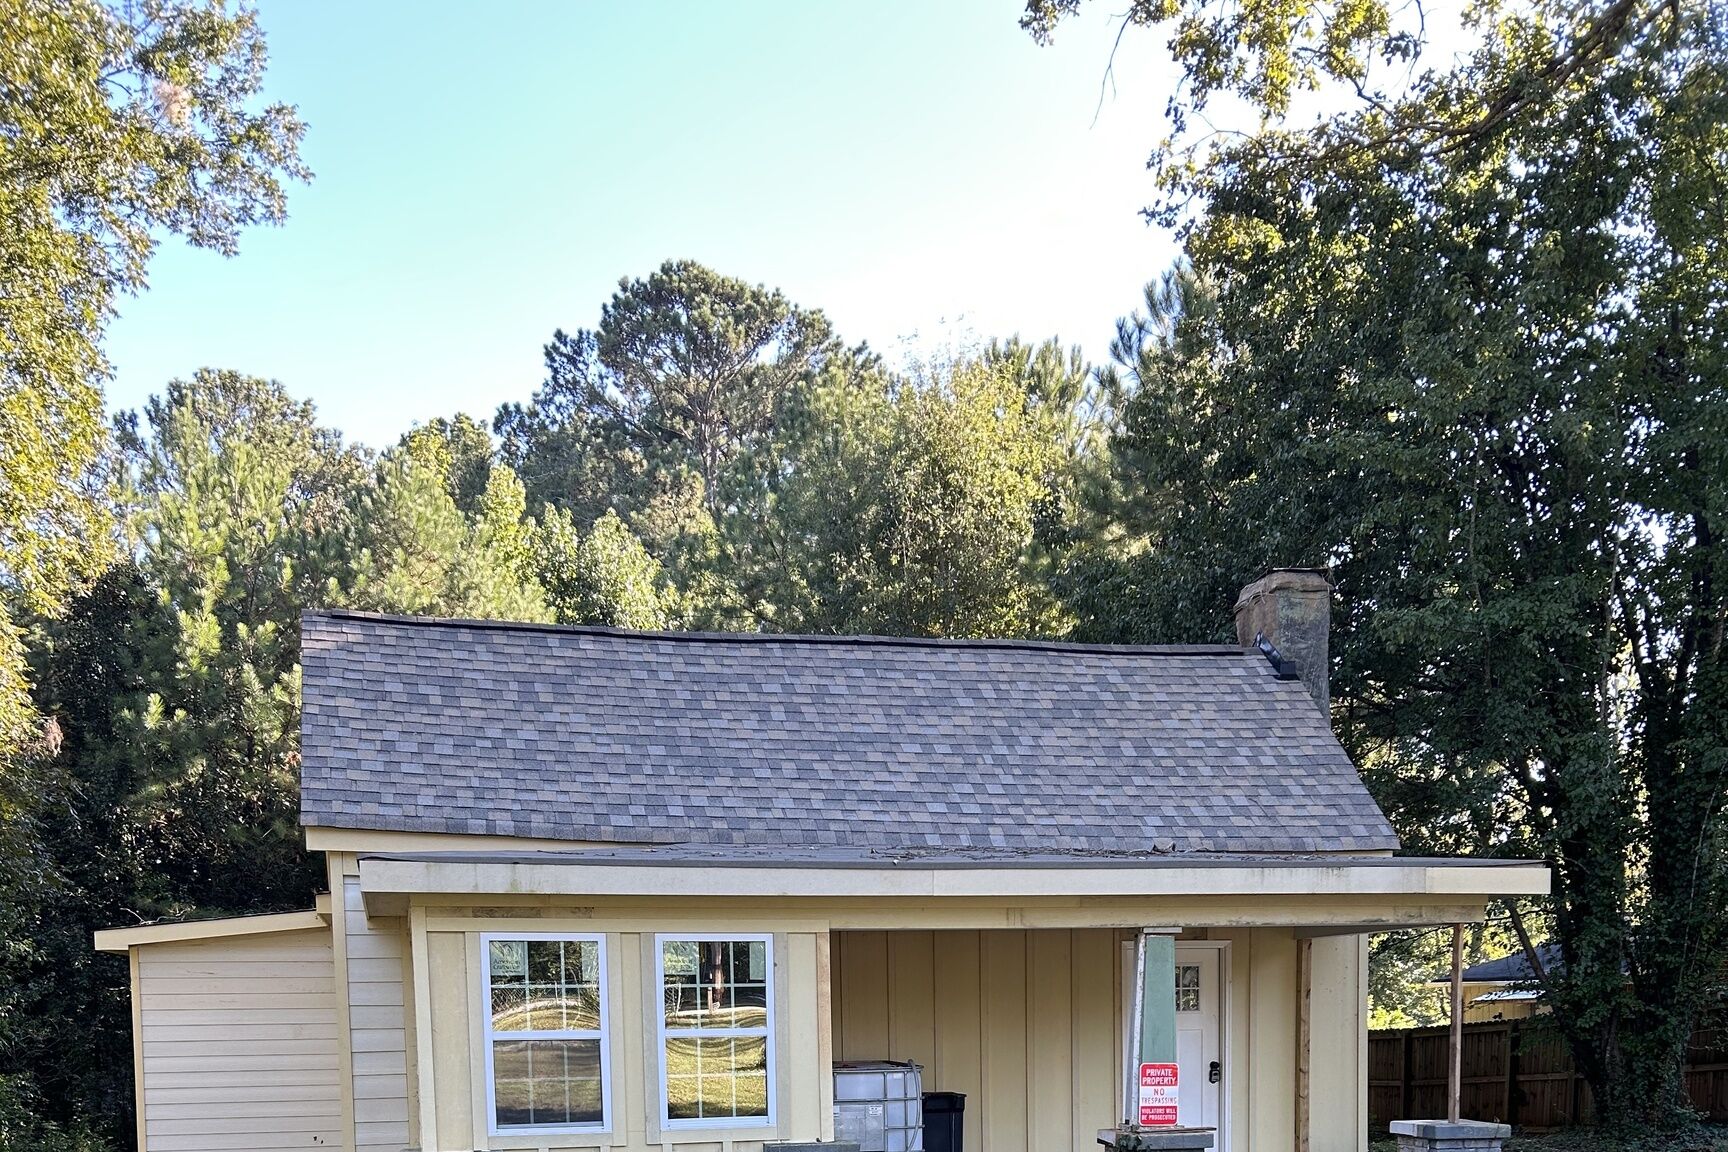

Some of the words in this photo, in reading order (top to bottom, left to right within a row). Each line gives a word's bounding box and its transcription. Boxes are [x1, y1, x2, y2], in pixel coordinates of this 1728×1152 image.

[1146, 1068, 1173, 1077] PRIVATE
[1142, 1077, 1176, 1085] PROPERTY
[1153, 1088, 1165, 1096] NO
[1141, 1097, 1177, 1105] TRESPASSING
